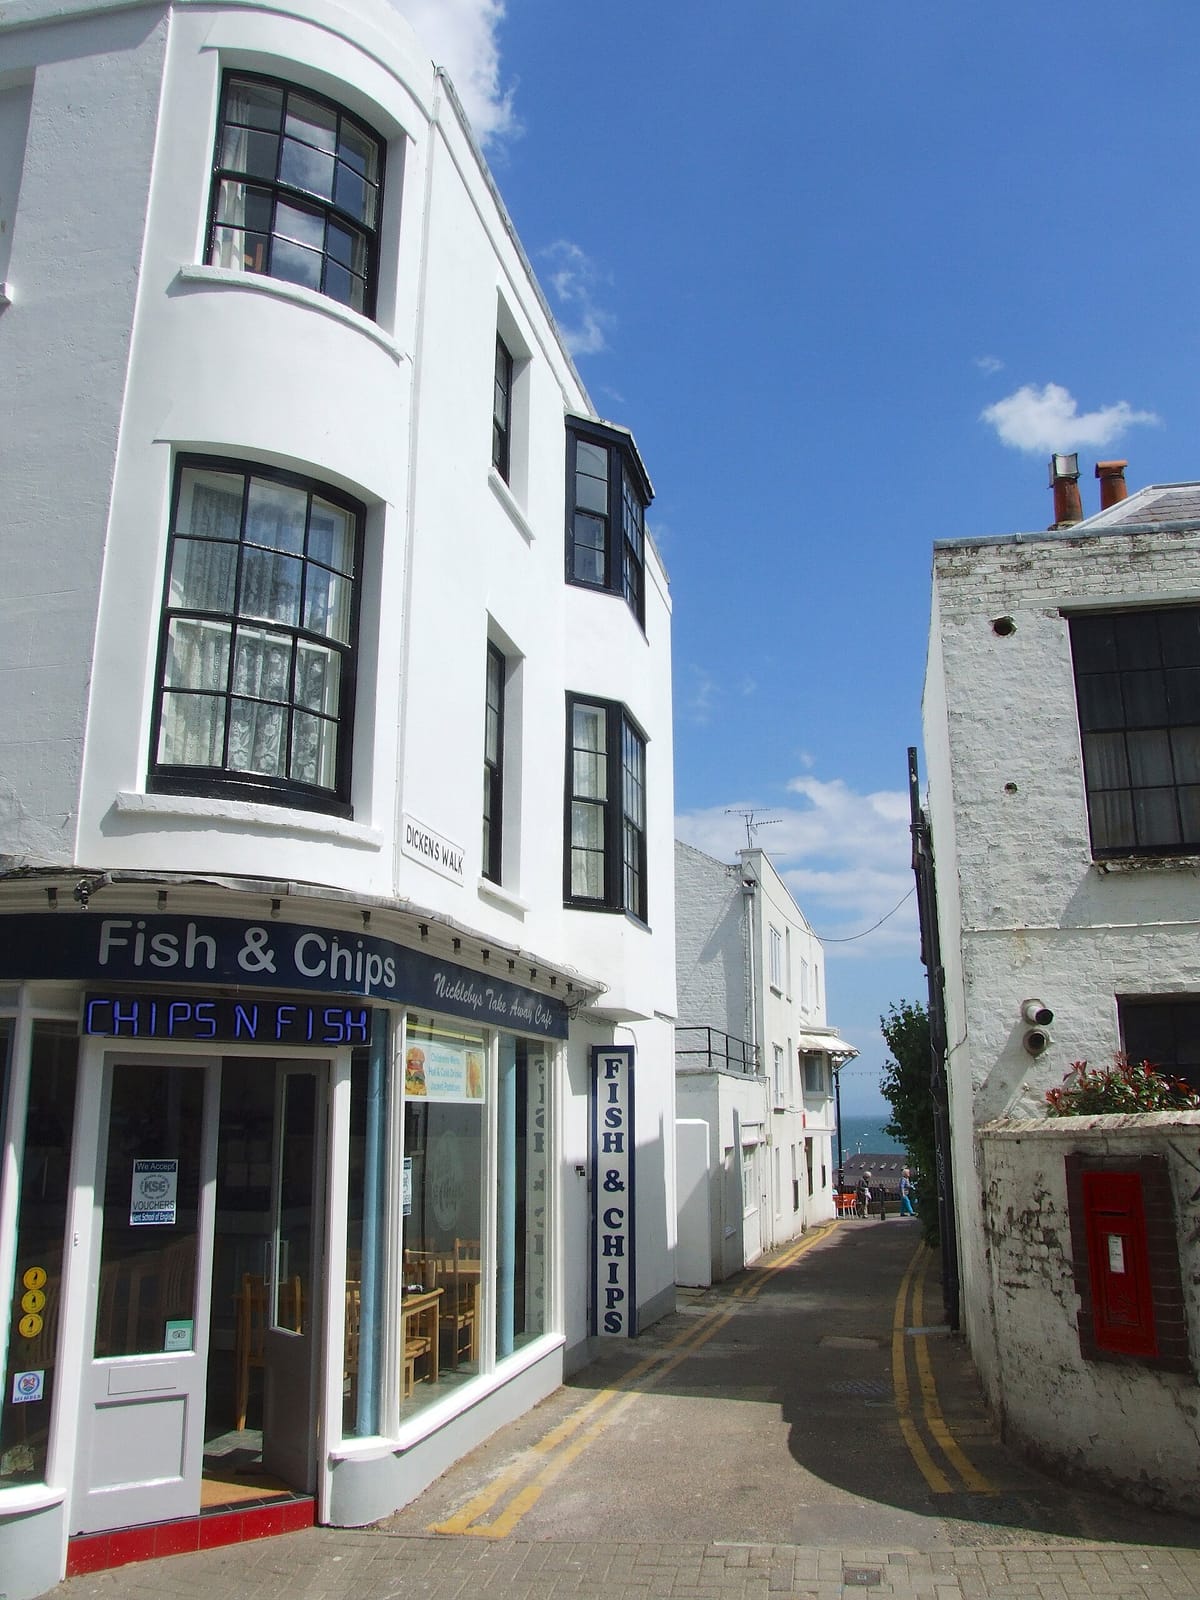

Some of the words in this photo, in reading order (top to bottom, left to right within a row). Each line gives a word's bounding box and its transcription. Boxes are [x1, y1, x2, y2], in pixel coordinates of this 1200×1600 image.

[406, 823, 440, 861] DICKENS
[442, 845, 463, 876] WALK
[98, 920, 217, 969] Fish
[237, 927, 277, 974] &
[294, 932, 396, 995] Chips
[87, 1000, 217, 1038] CHIPS
[234, 1004, 258, 1039] N
[275, 1006, 367, 1042] FISH
[433, 972, 483, 1011] Nicklebys
[485, 988, 507, 1013] Take
[509, 998, 533, 1025] Away
[534, 1004, 553, 1030] Cafe
[602, 1058, 625, 1154] FISH
[137, 1161, 149, 1171] We
[151, 1161, 176, 1172] Accept
[144, 1180, 166, 1193] KSE
[603, 1169, 625, 1193] &
[133, 1200, 175, 1210] VOUCHERS
[602, 1207, 625, 1334] CHIPS
